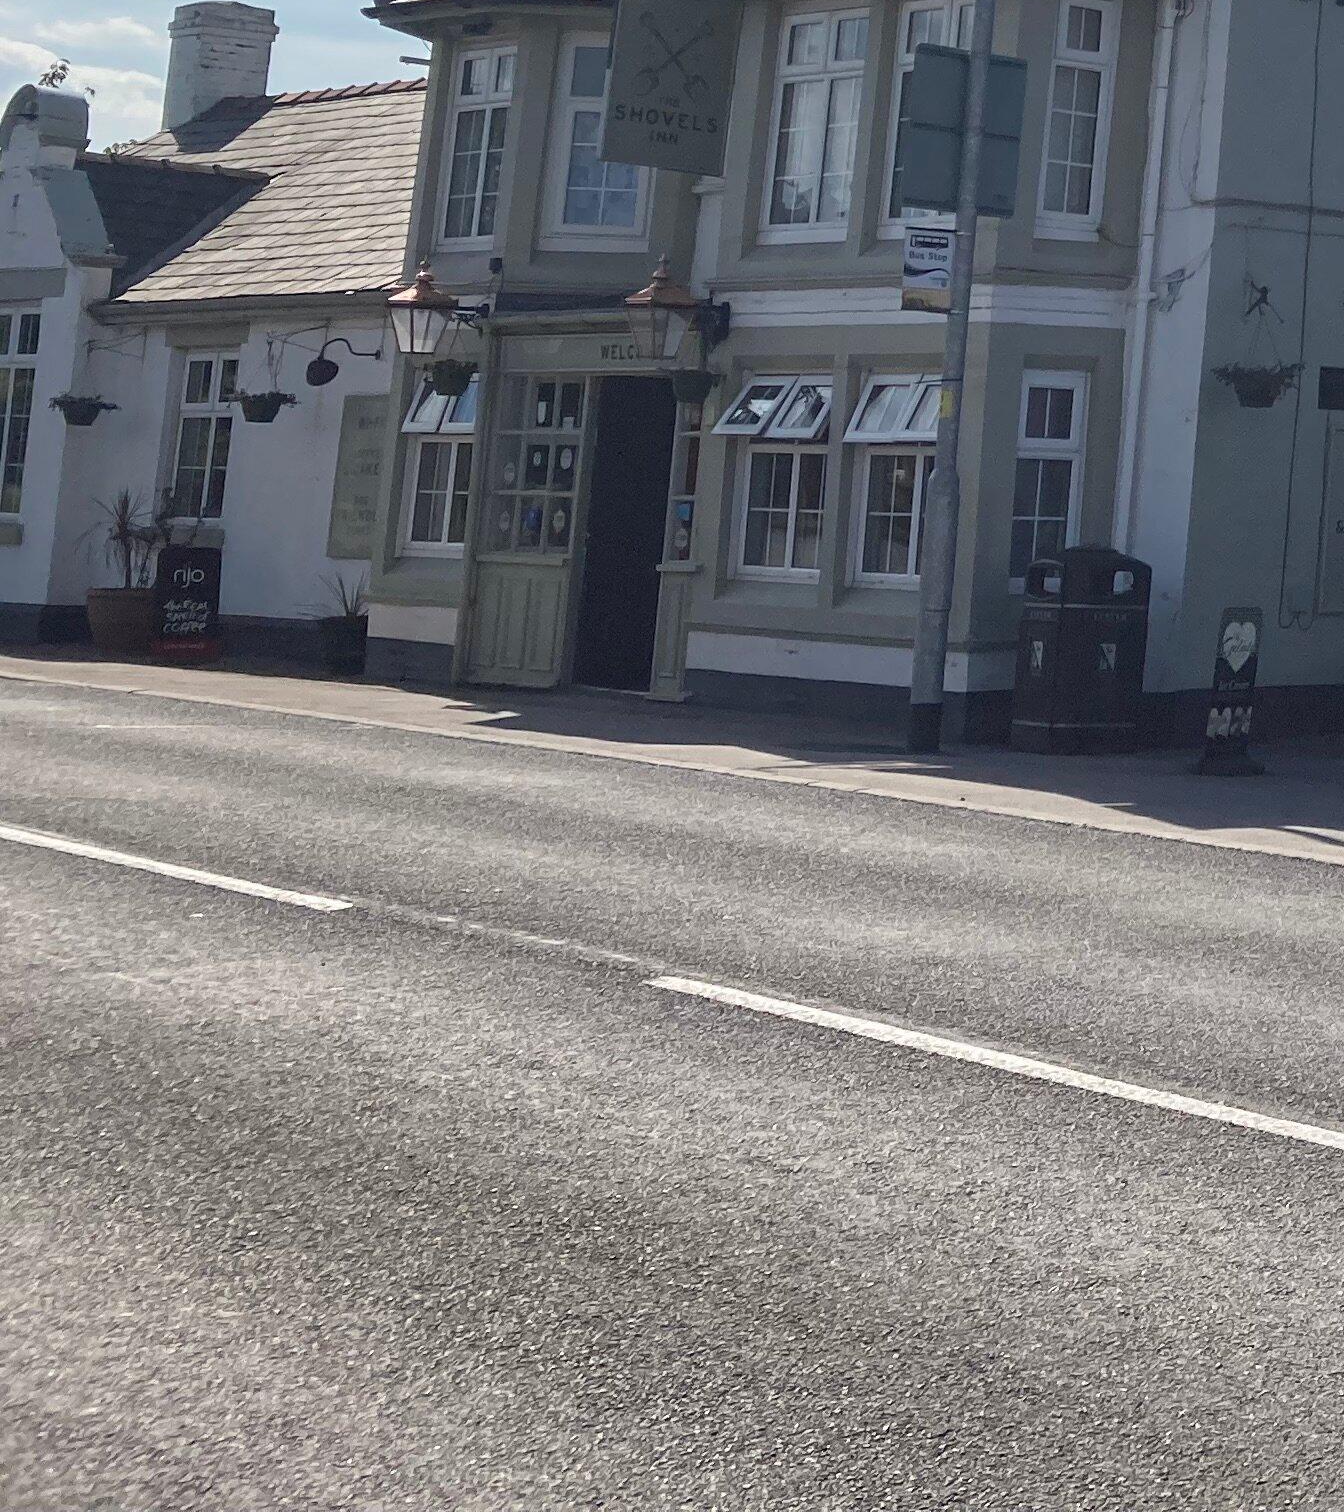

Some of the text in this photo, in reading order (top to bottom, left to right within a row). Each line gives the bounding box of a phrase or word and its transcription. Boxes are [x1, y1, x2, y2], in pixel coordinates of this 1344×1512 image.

[614, 104, 719, 134] SHOVELS
[648, 130, 679, 145] INN
[928, 251, 948, 263] Stop
